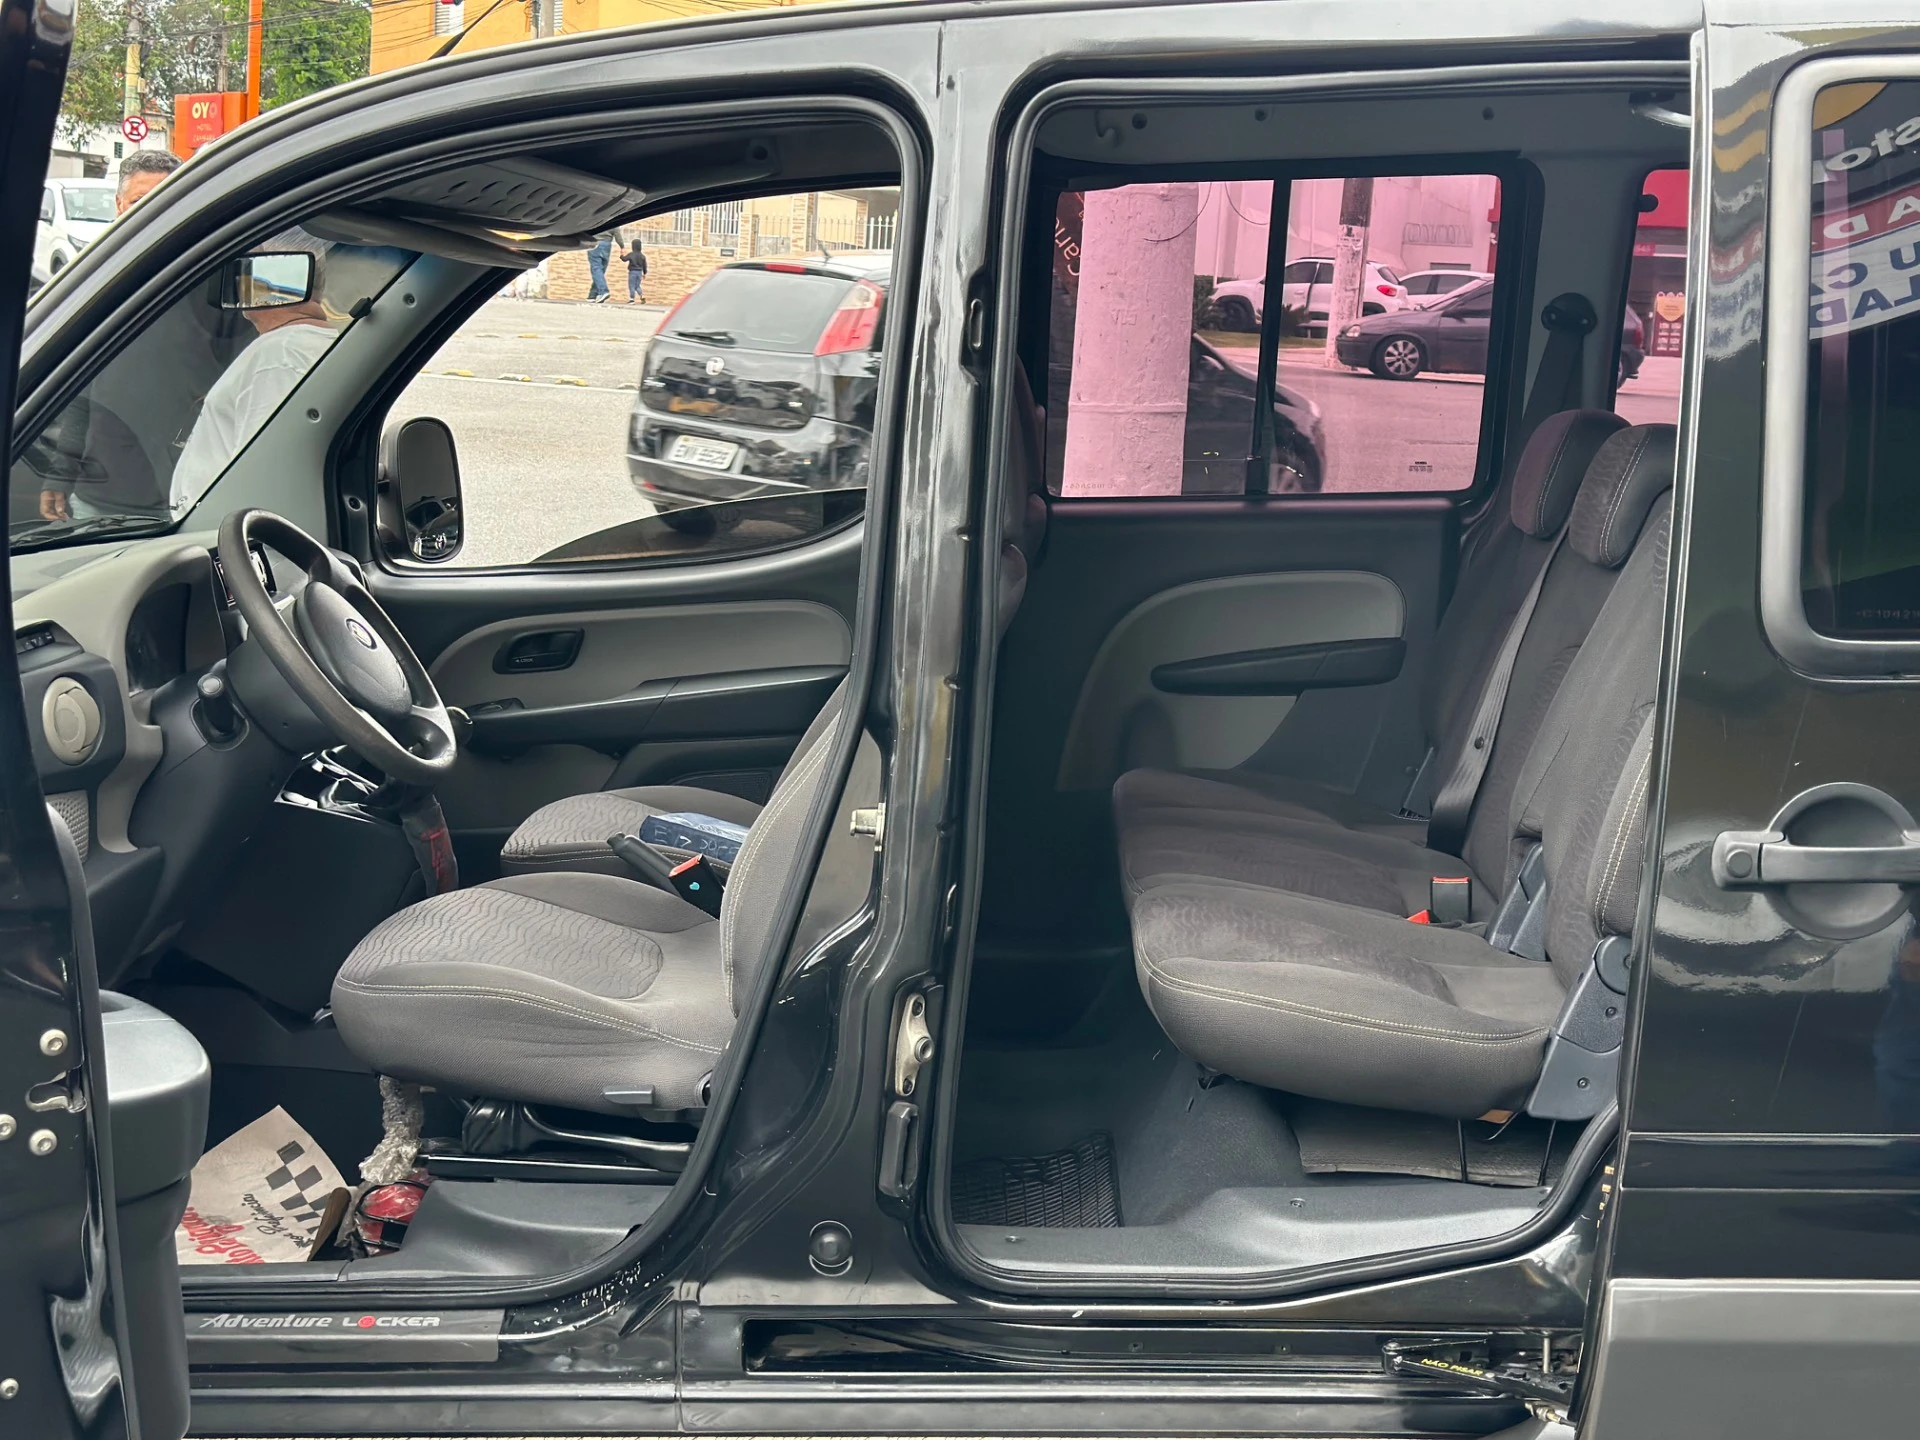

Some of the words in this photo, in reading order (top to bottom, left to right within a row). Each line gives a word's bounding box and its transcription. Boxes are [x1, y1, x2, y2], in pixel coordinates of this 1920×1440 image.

[192, 101, 218, 119] OYO
[199, 1314, 333, 1328] Adventure
[342, 1315, 440, 1329] LOCKER
